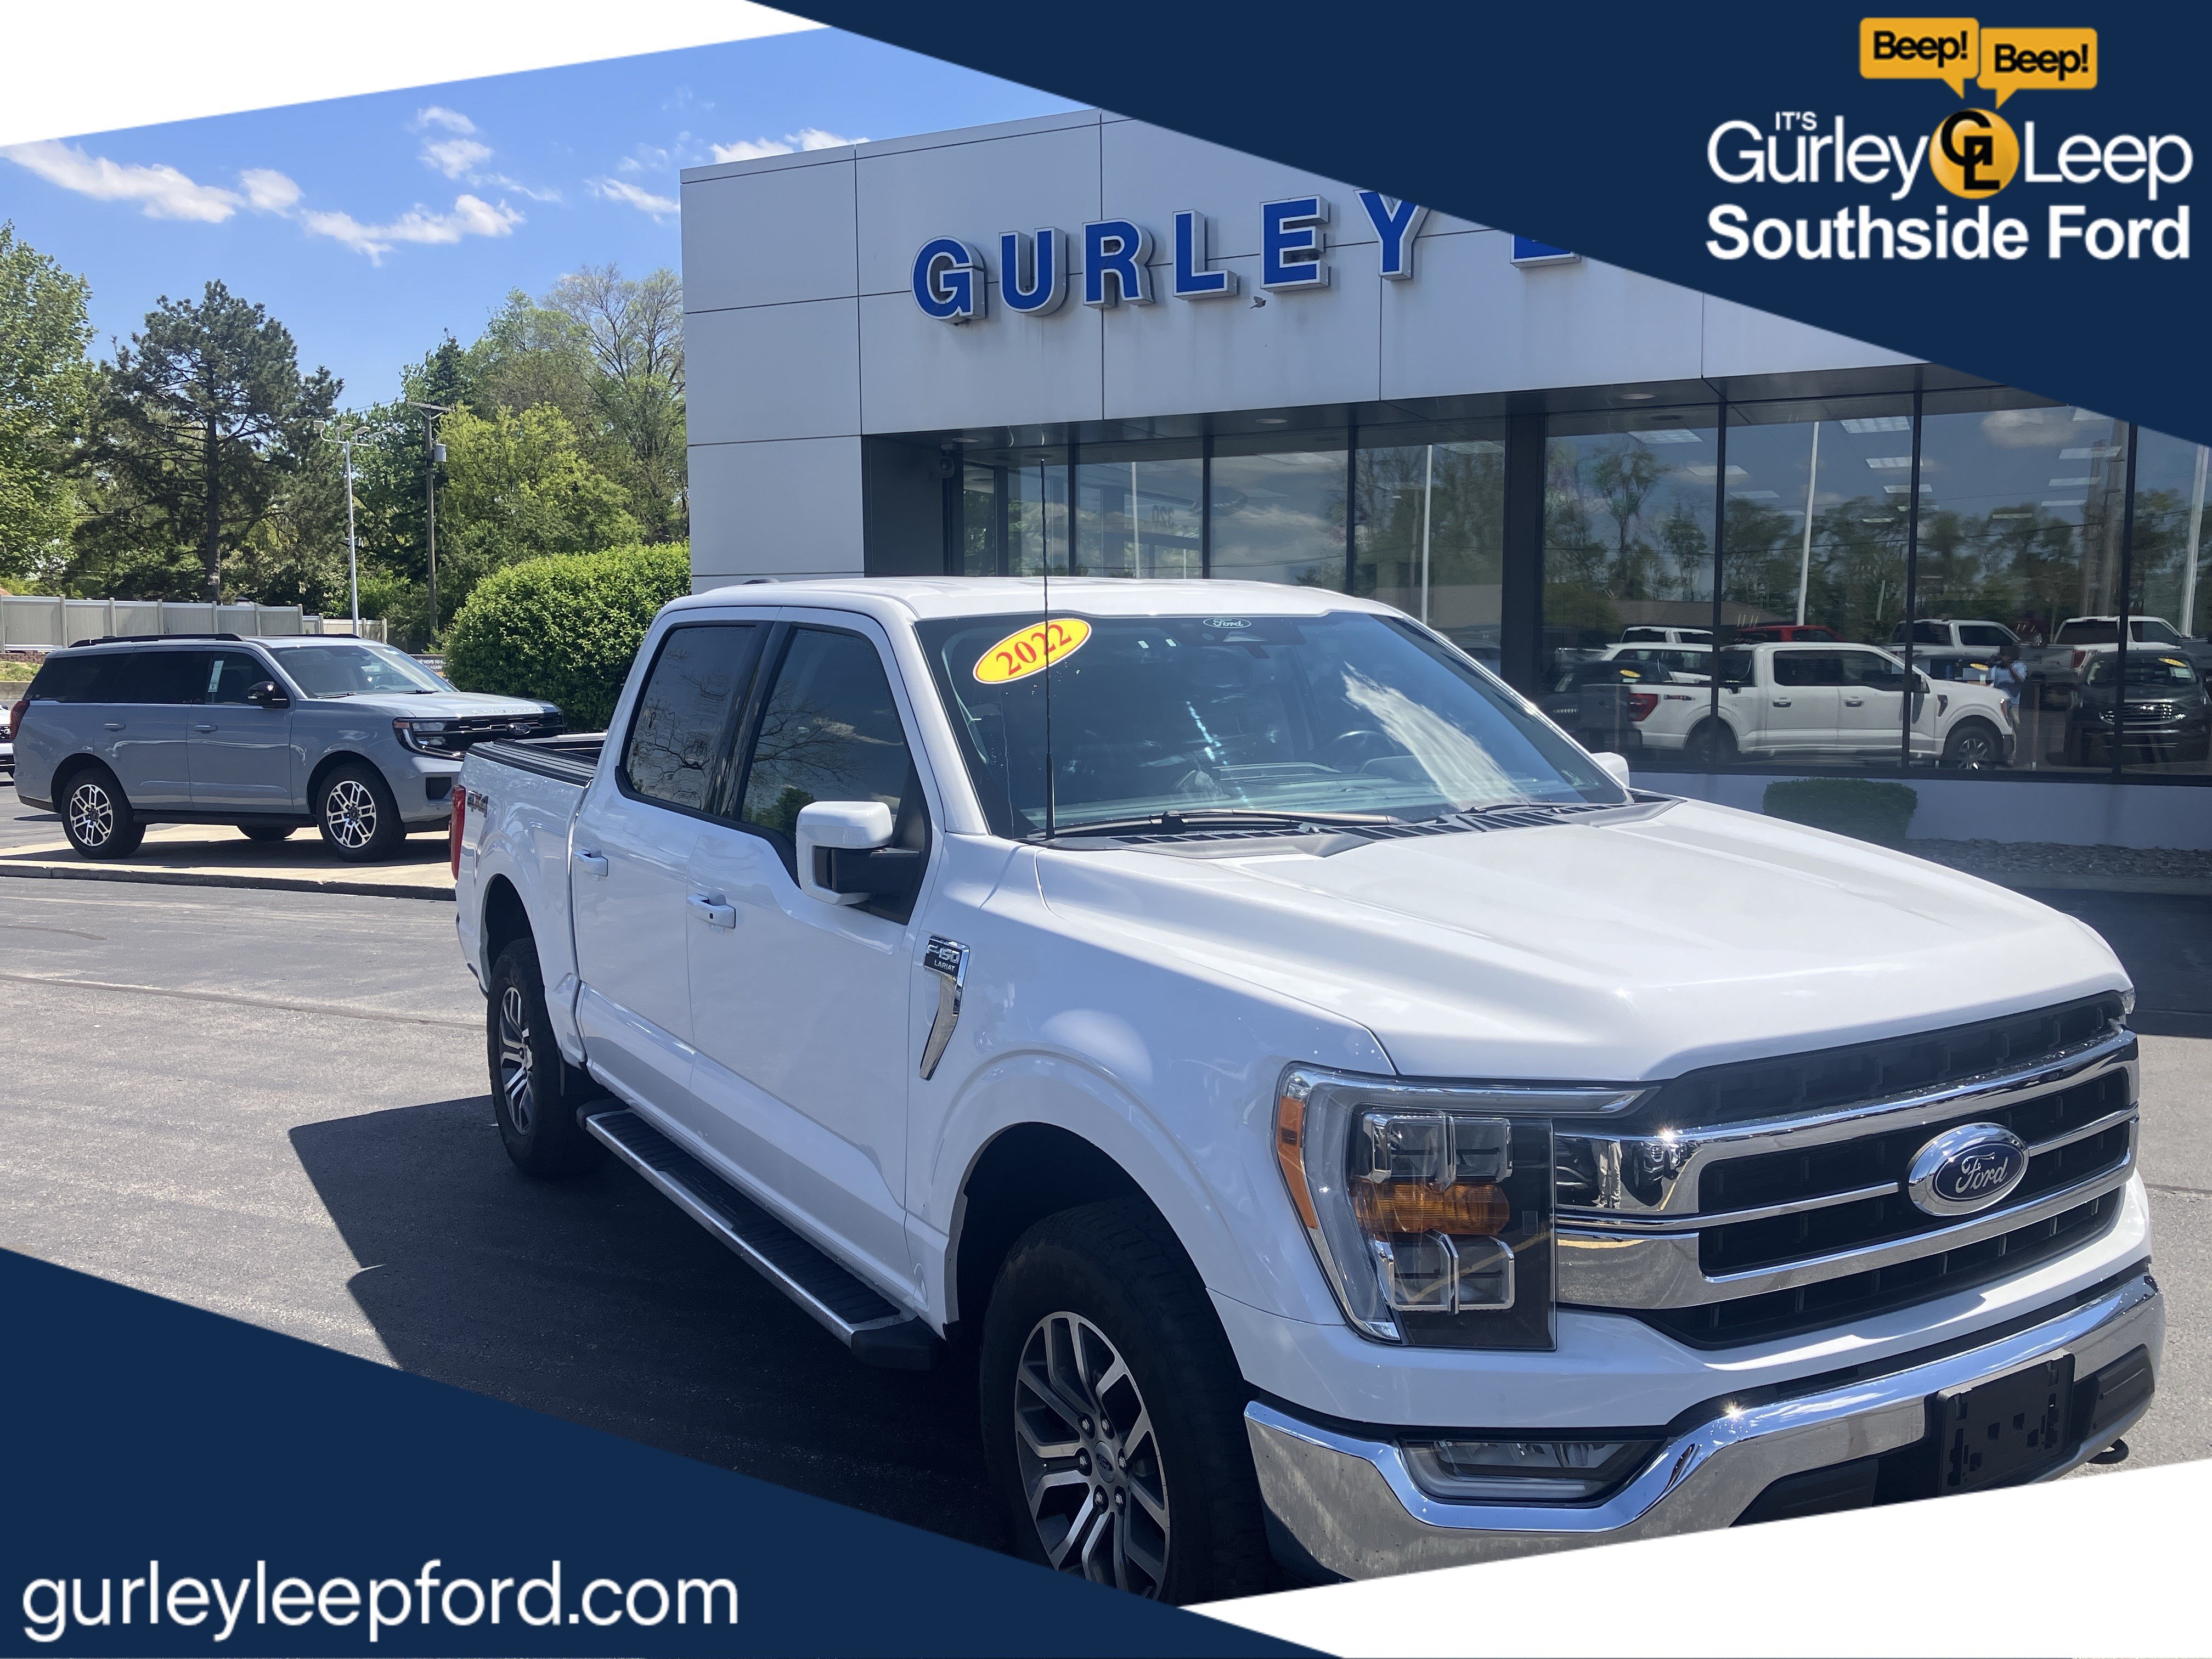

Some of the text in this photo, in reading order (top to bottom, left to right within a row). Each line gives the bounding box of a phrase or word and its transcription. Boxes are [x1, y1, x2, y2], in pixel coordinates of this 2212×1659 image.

[911, 188, 1427, 323] GURLEY
[1212, 618, 1244, 627] Ford
[995, 624, 1073, 676] 2022
[926, 944, 961, 964] F-150
[934, 960, 956, 972] LARIAT
[1955, 1152, 2008, 1193] Ford
